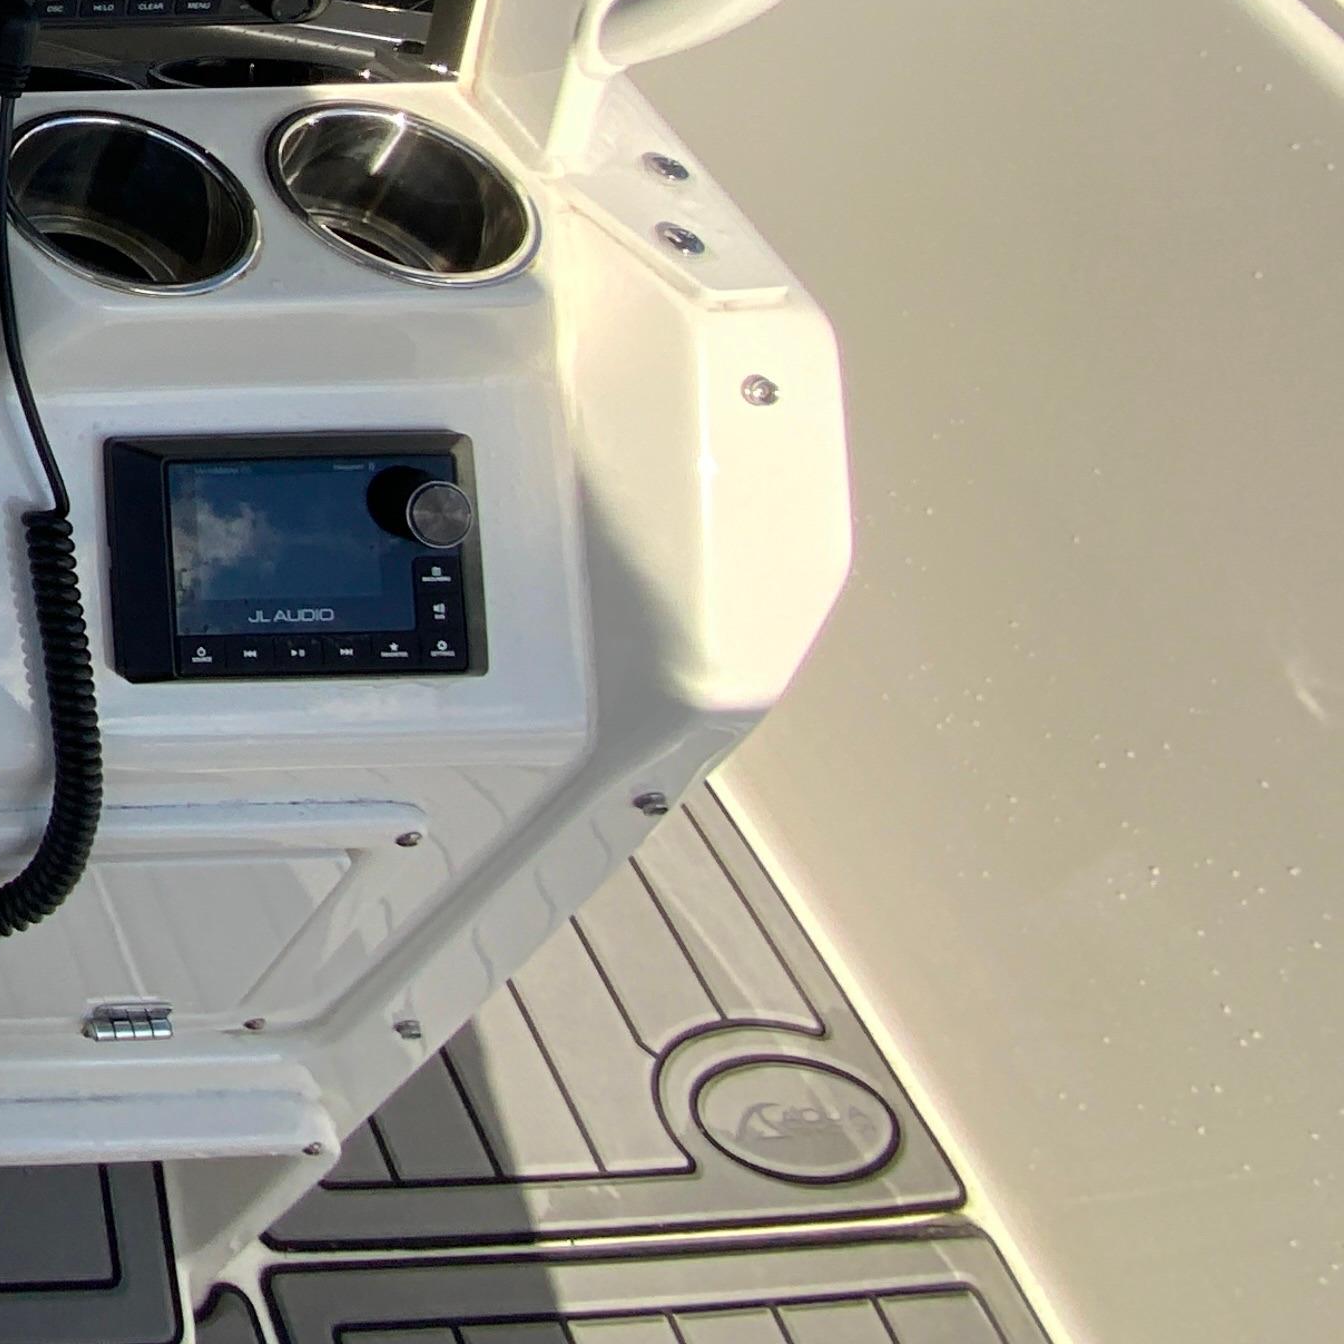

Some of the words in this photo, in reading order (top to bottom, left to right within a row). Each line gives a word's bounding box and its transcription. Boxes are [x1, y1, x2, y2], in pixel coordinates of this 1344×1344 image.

[187, 1, 211, 9] MENU
[247, 609, 271, 622] JL
[273, 608, 335, 622] AUDIO
